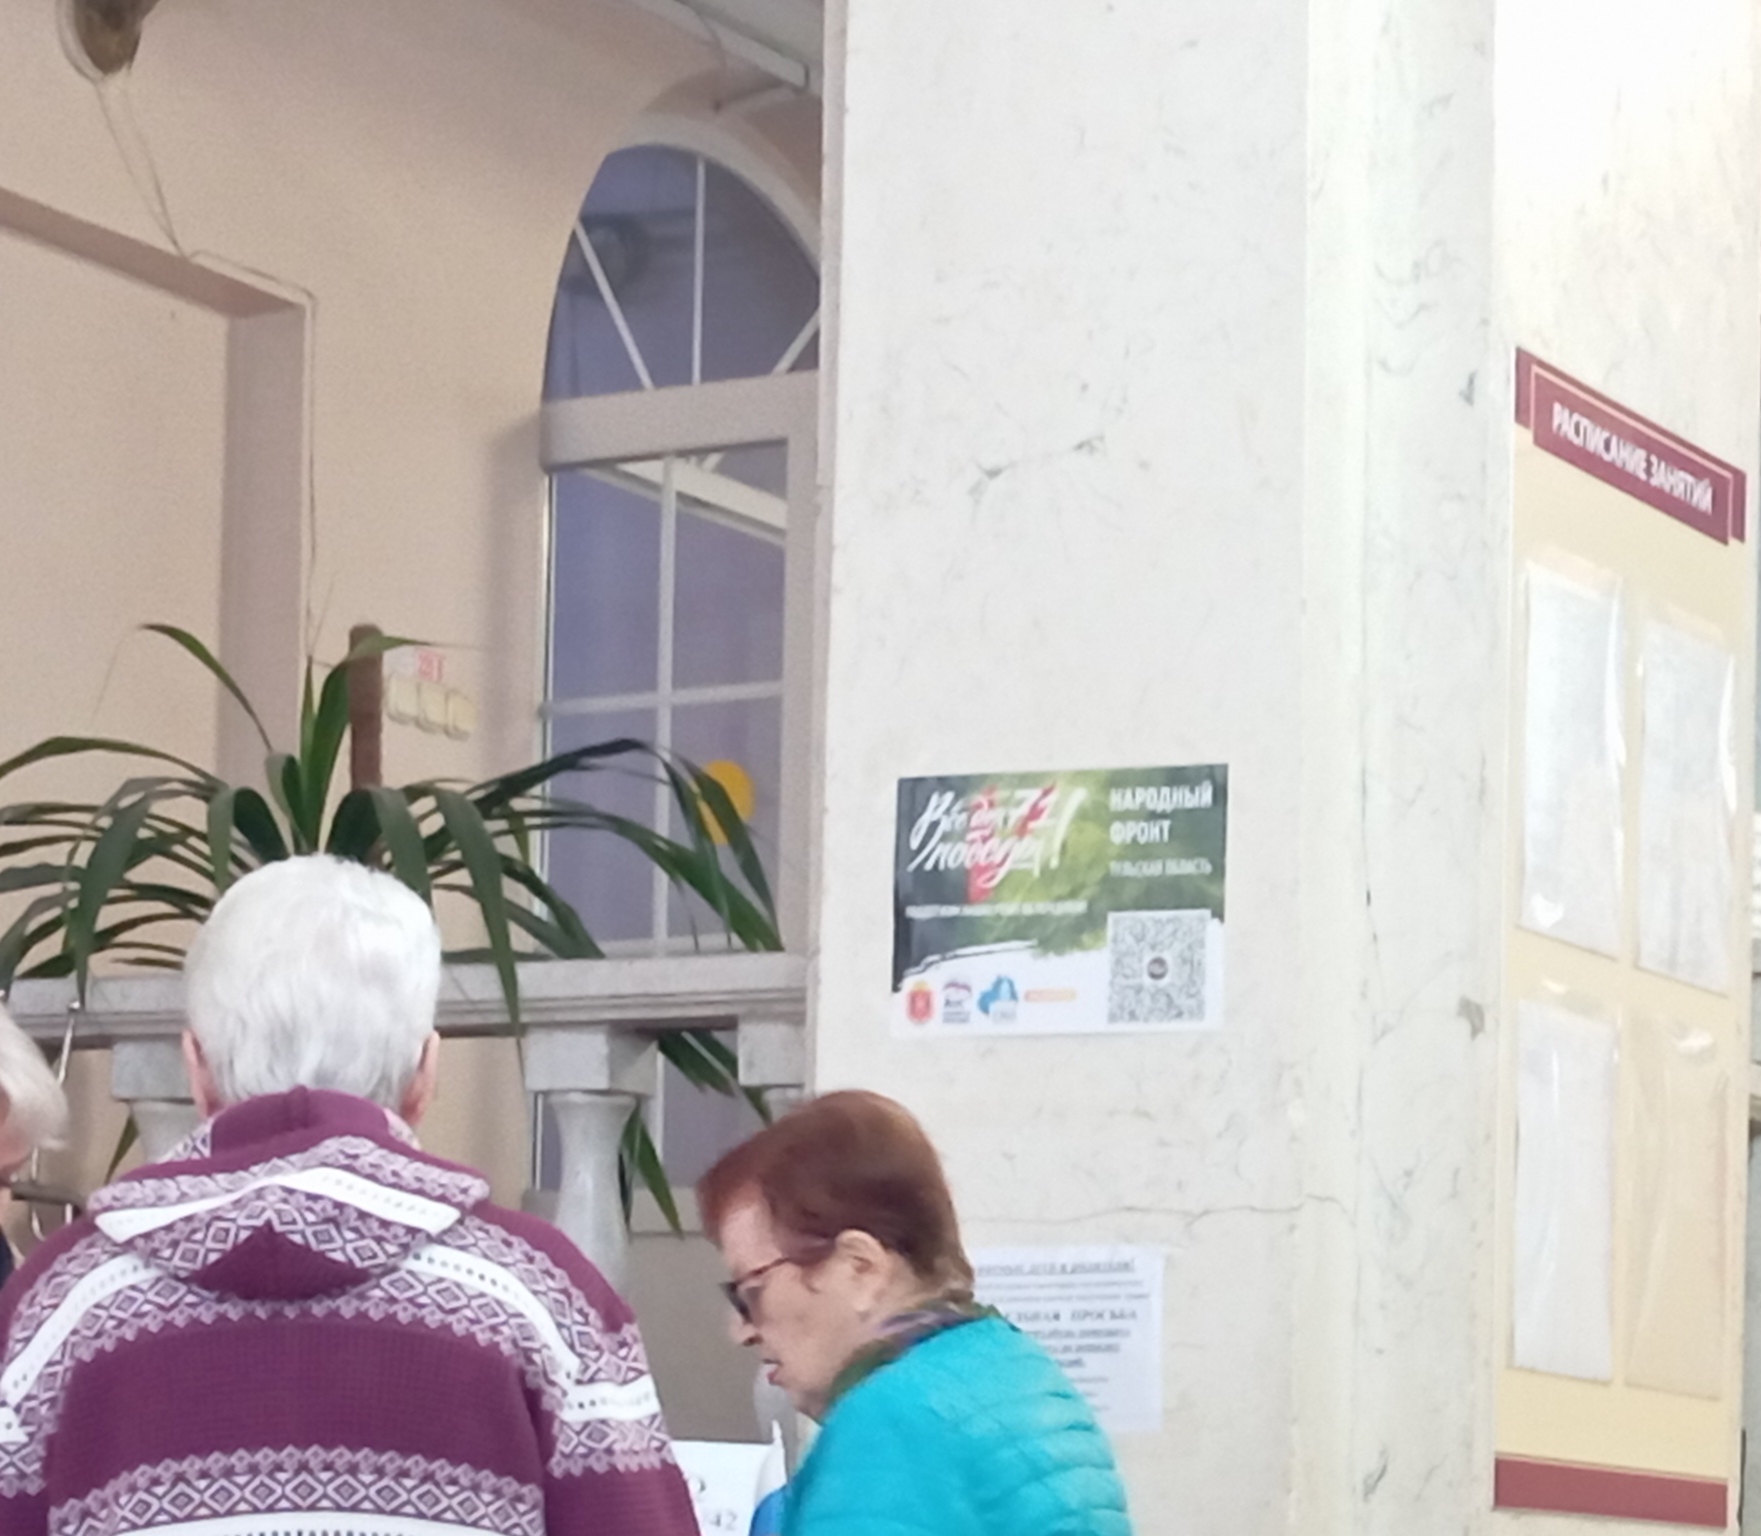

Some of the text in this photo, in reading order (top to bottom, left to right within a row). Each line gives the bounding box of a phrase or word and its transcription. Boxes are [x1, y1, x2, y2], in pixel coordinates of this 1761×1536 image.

[1552, 400, 1713, 516] РАСПИСАНИЕ ЗАНЯТИЙ
[1110, 780, 1214, 812] НАРОДНЫЙ
[1110, 819, 1172, 845] ФРОНТ
